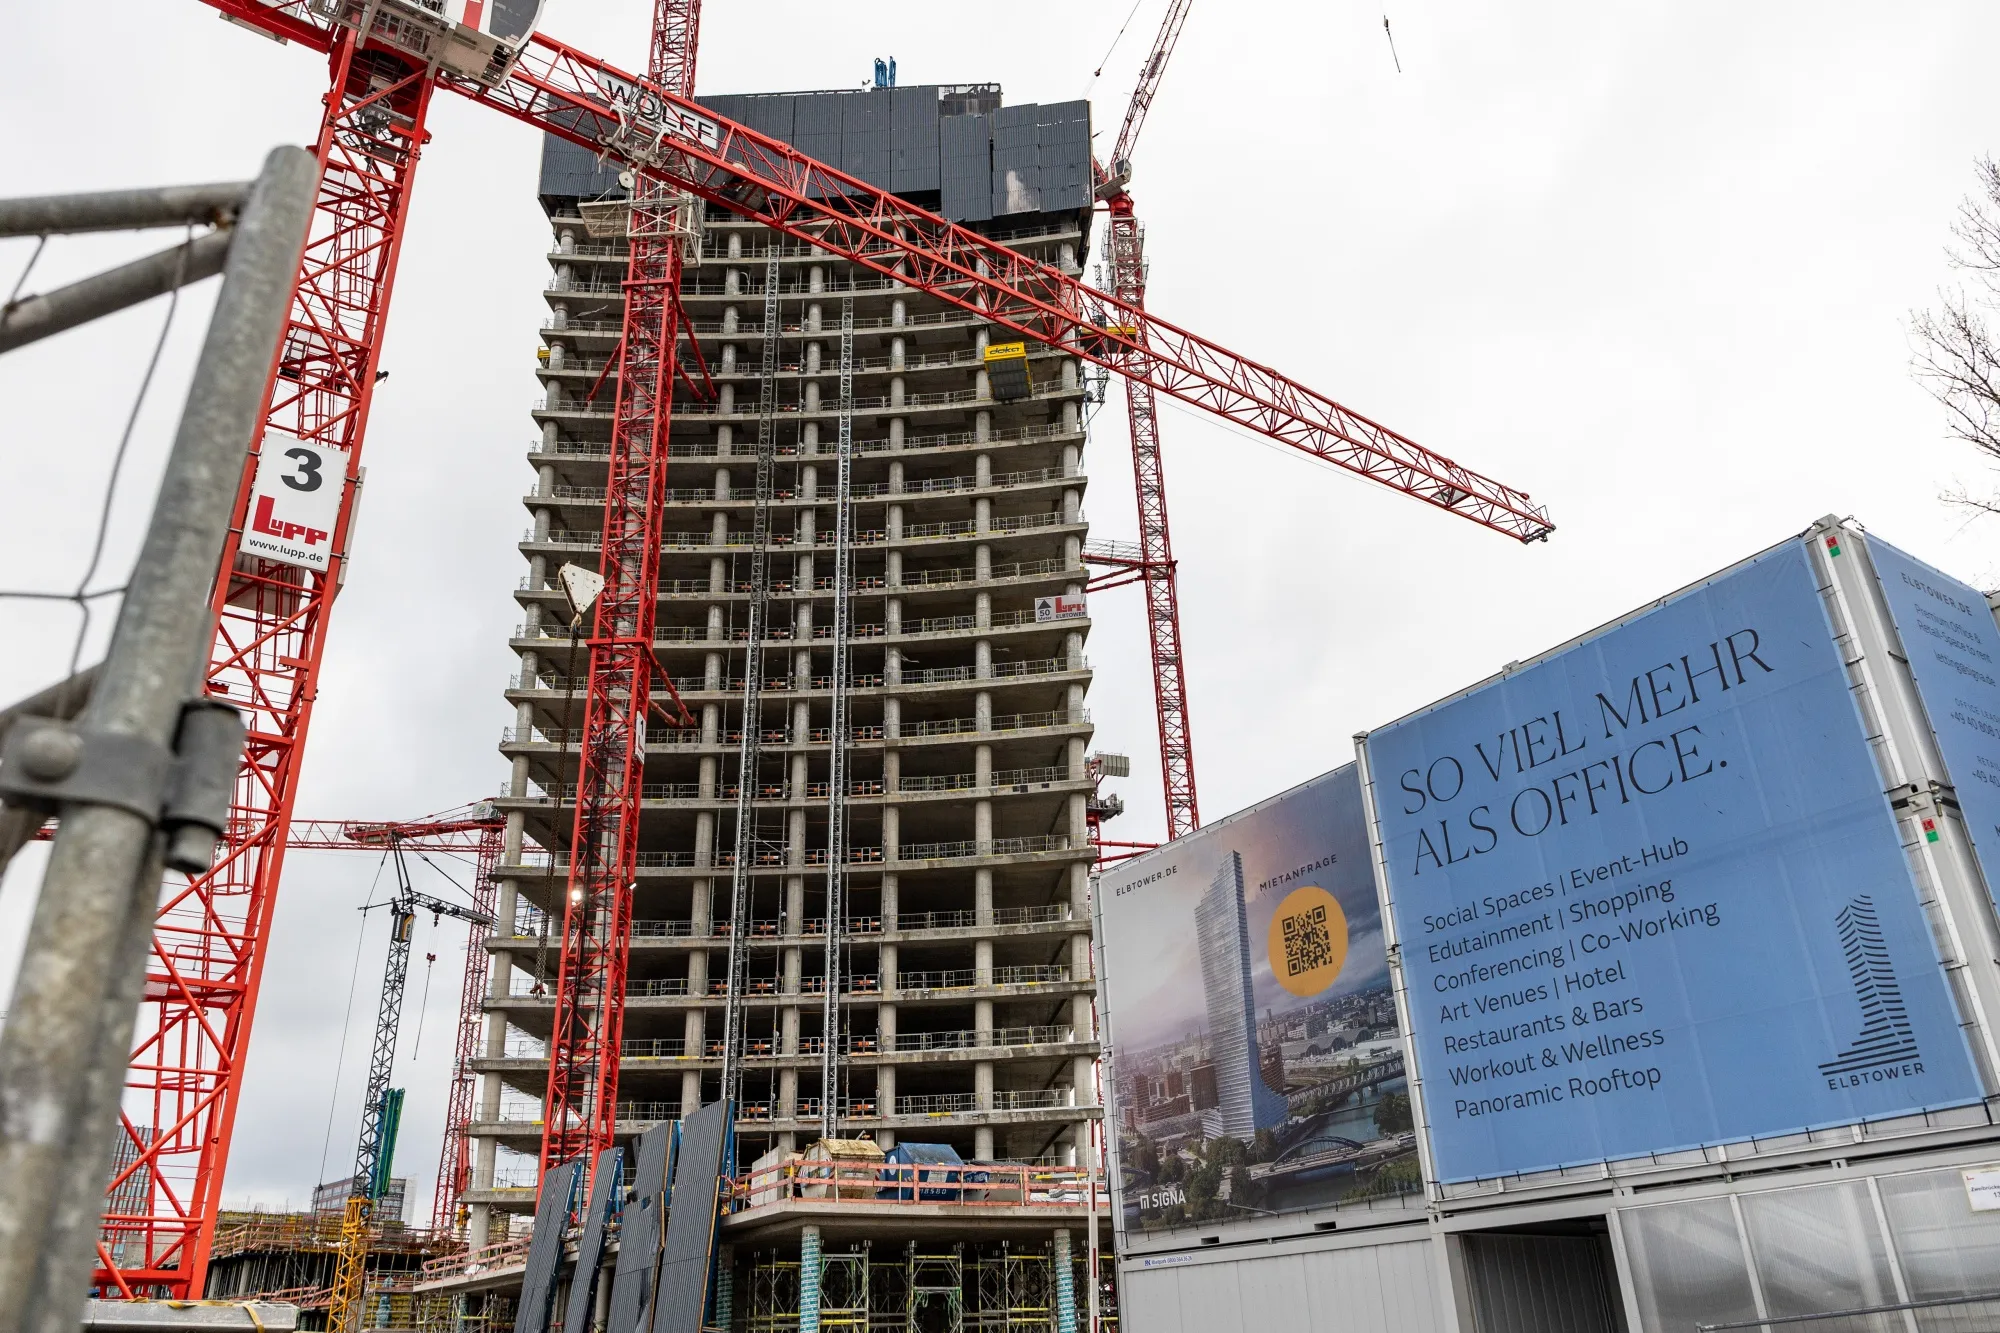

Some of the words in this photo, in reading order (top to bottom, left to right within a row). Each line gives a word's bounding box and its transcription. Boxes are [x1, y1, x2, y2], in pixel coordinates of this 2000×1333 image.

[280, 448, 323, 492] 3
[249, 538, 323, 563] www.lupp.de
[1039, 609, 1051, 617] 50
[1055, 611, 1086, 619] ELBTOWER
[1901, 572, 1973, 617] ELBTOWER.DE
[1400, 756, 1464, 815] SO
[1474, 710, 1587, 782] VIEL
[1594, 628, 1775, 739] MEHR
[1413, 805, 1498, 876] ALS
[1510, 725, 1728, 837] OFFICE.
[1115, 865, 1178, 897] ELBTOWER.DE
[1259, 853, 1338, 892] MIETANFRAGE
[1423, 909, 1479, 934] Social
[1482, 881, 1554, 918] Spaces
[1570, 836, 1689, 889] Event-Hub
[1428, 912, 1554, 964] Edutainment
[1568, 879, 1675, 923] Shopping
[1433, 946, 1565, 993] Conferencing
[1580, 902, 1721, 954] Co-Working
[1440, 1003, 1471, 1024] Art
[1474, 983, 1548, 1015] Venues
[1564, 959, 1626, 994] Hotel
[1444, 1012, 1566, 1055] Restaurants
[1571, 1006, 1590, 1026] &
[1592, 996, 1644, 1022] Bars
[1449, 1053, 1537, 1086] Workout
[1541, 1048, 1559, 1068] &
[1561, 1028, 1665, 1064] Wellness
[1827, 1062, 1925, 1091] ELBTOWER
[1454, 1083, 1564, 1119] Panoramic
[1568, 1066, 1662, 1099] Rooftop
[1151, 1189, 1187, 1208] SIGNA
